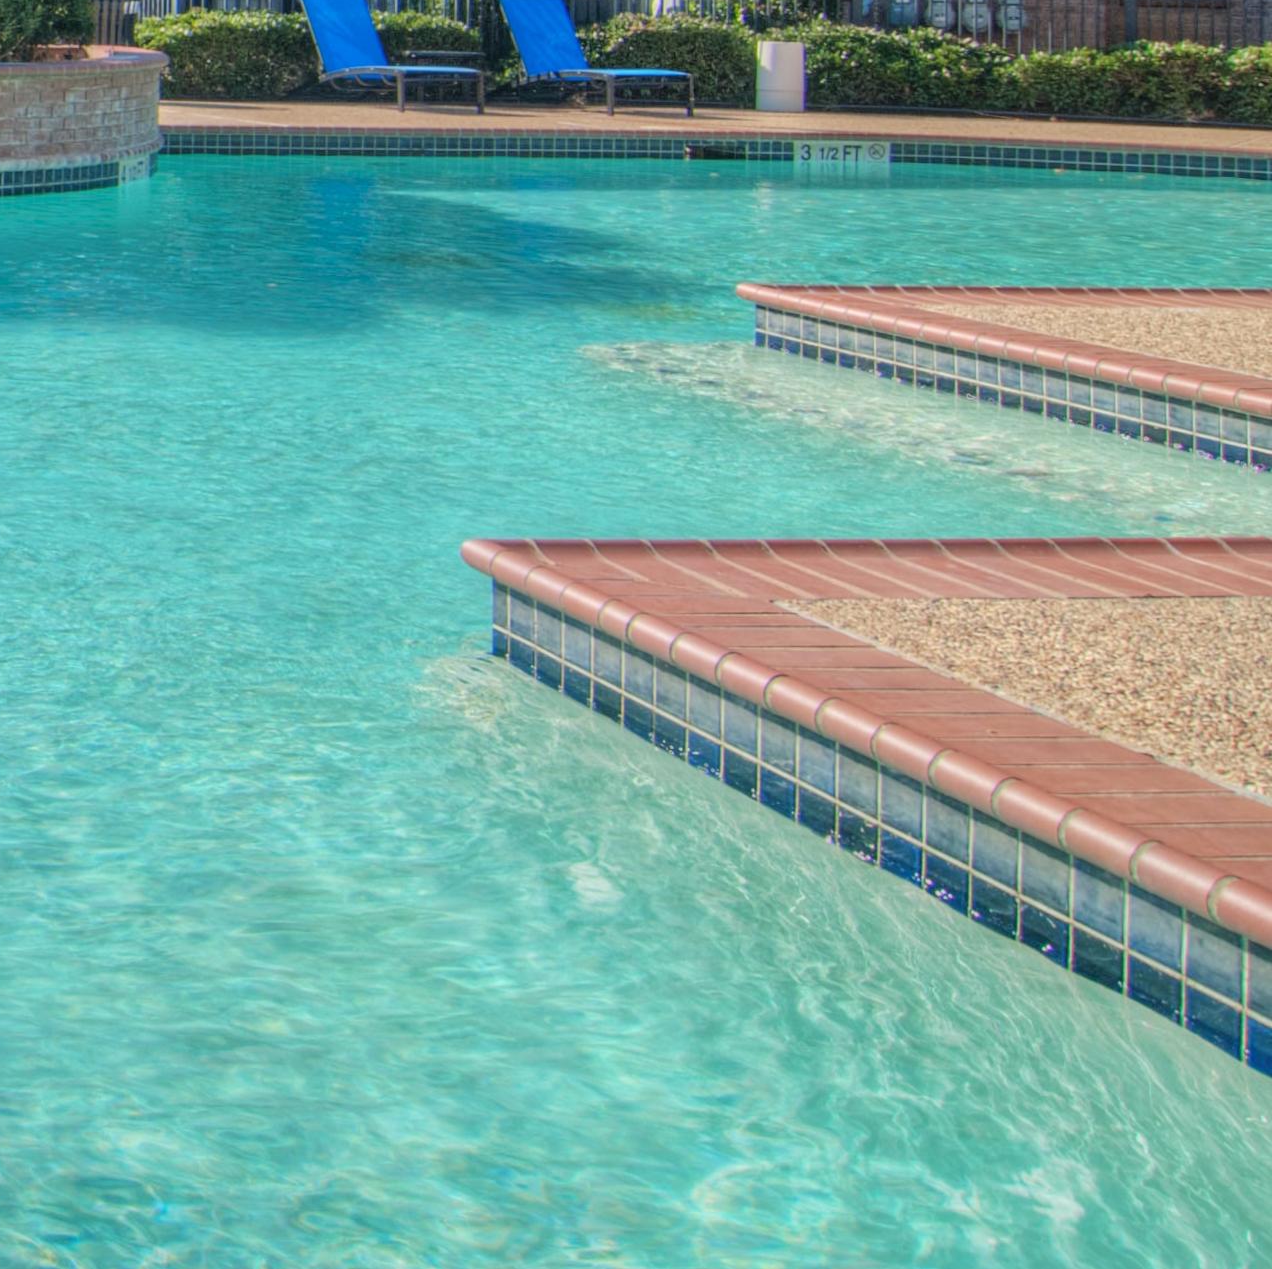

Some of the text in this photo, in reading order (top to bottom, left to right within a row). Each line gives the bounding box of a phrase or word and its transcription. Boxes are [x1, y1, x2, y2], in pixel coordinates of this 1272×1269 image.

[800, 143, 862, 162] 3 1/2 FT
